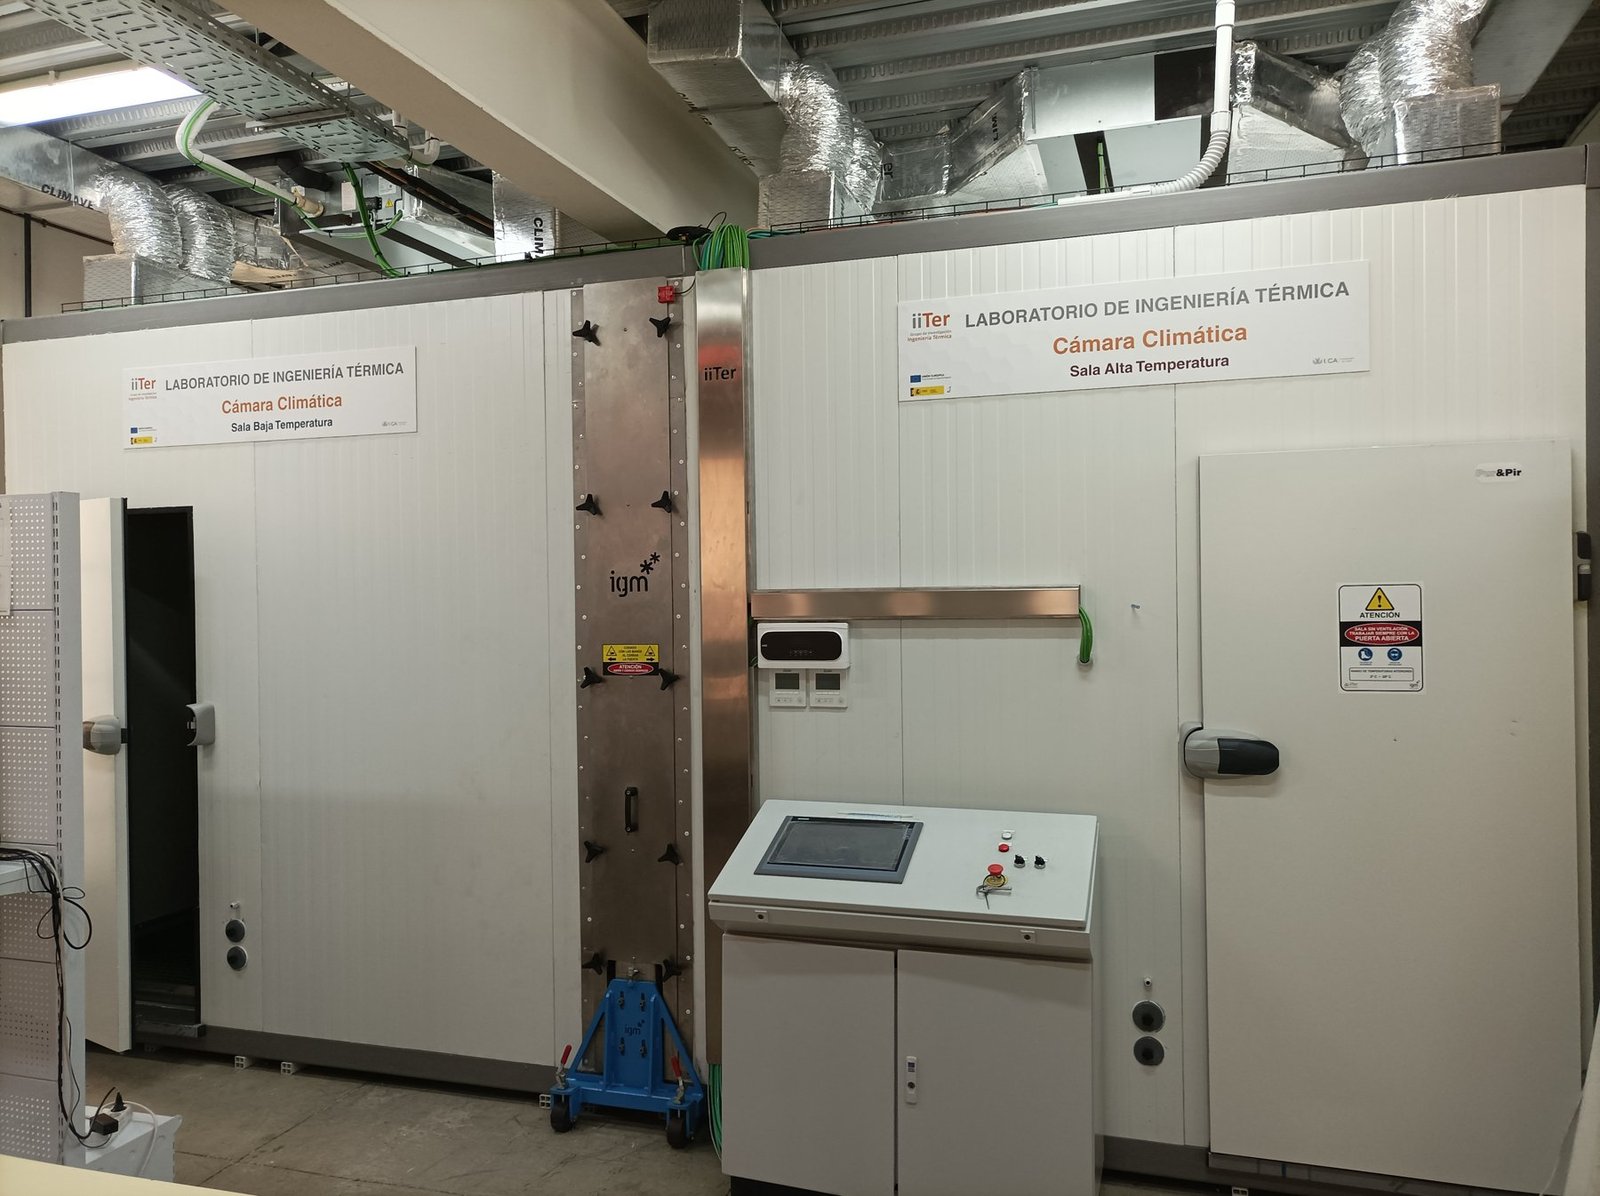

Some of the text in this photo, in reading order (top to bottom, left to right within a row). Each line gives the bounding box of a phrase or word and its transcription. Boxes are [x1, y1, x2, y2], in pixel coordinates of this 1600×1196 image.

[965, 280, 1350, 328] LABORATORIO DE INGENIERÍA TÉRMICA
[912, 312, 950, 328] iiTer
[1053, 324, 1248, 356] Cámara Climática
[166, 362, 404, 391] LABORATORIO DE INGENIERÍA TÉRMICA
[704, 367, 736, 381] iiTer
[1070, 356, 1230, 378] Sala Alta Temperatura
[131, 378, 156, 391] iiTer
[222, 395, 342, 414] Cámara Climática
[232, 419, 333, 432] Sala Baja Temperatura
[610, 570, 648, 597] igm
